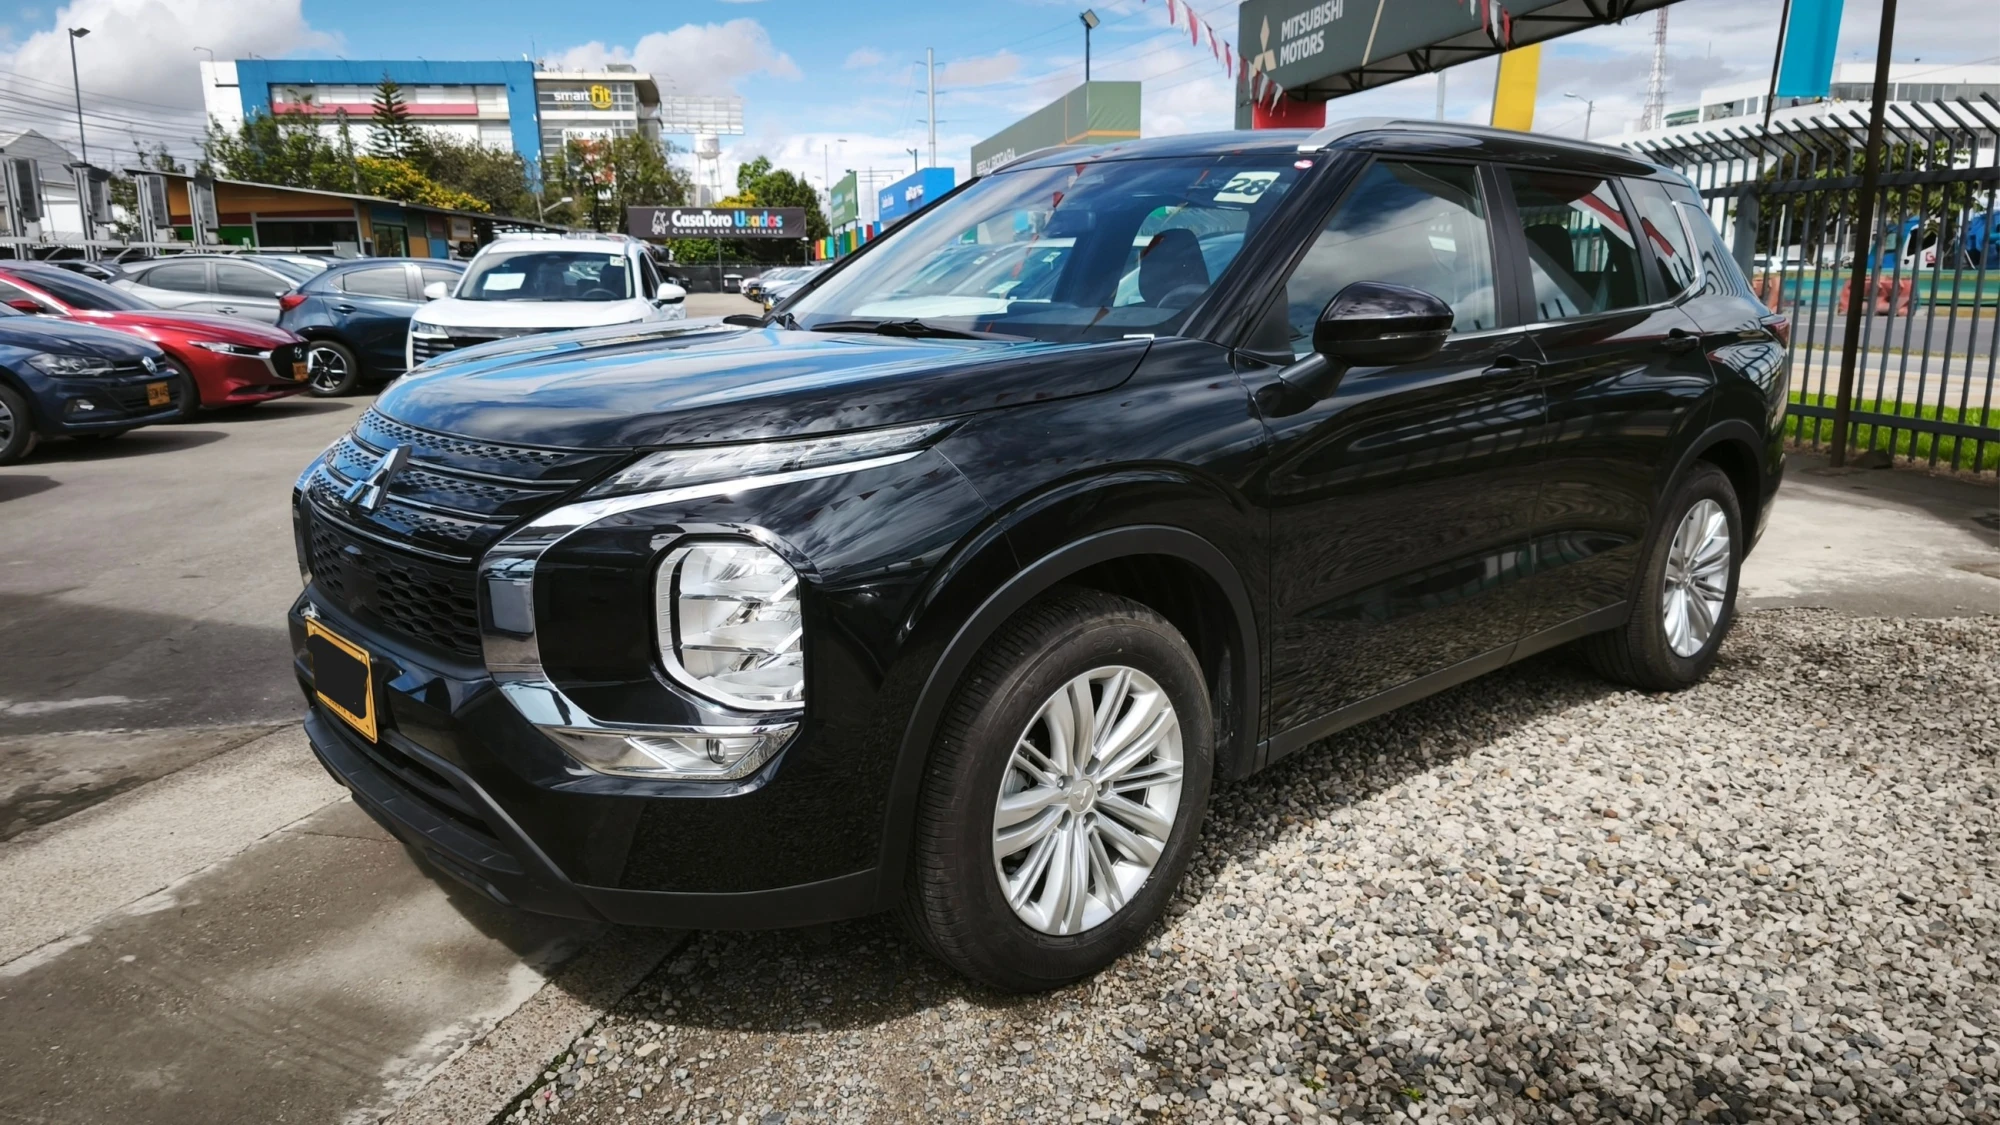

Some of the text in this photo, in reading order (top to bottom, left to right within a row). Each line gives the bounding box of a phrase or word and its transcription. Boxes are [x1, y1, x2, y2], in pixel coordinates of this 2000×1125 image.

[1281, 0, 1344, 41] MITSUBISHI
[1280, 30, 1325, 67] MOTORS
[553, 84, 613, 104] smart fit
[1221, 178, 1272, 196] 28
[671, 210, 783, 227] CasaToro Usados
